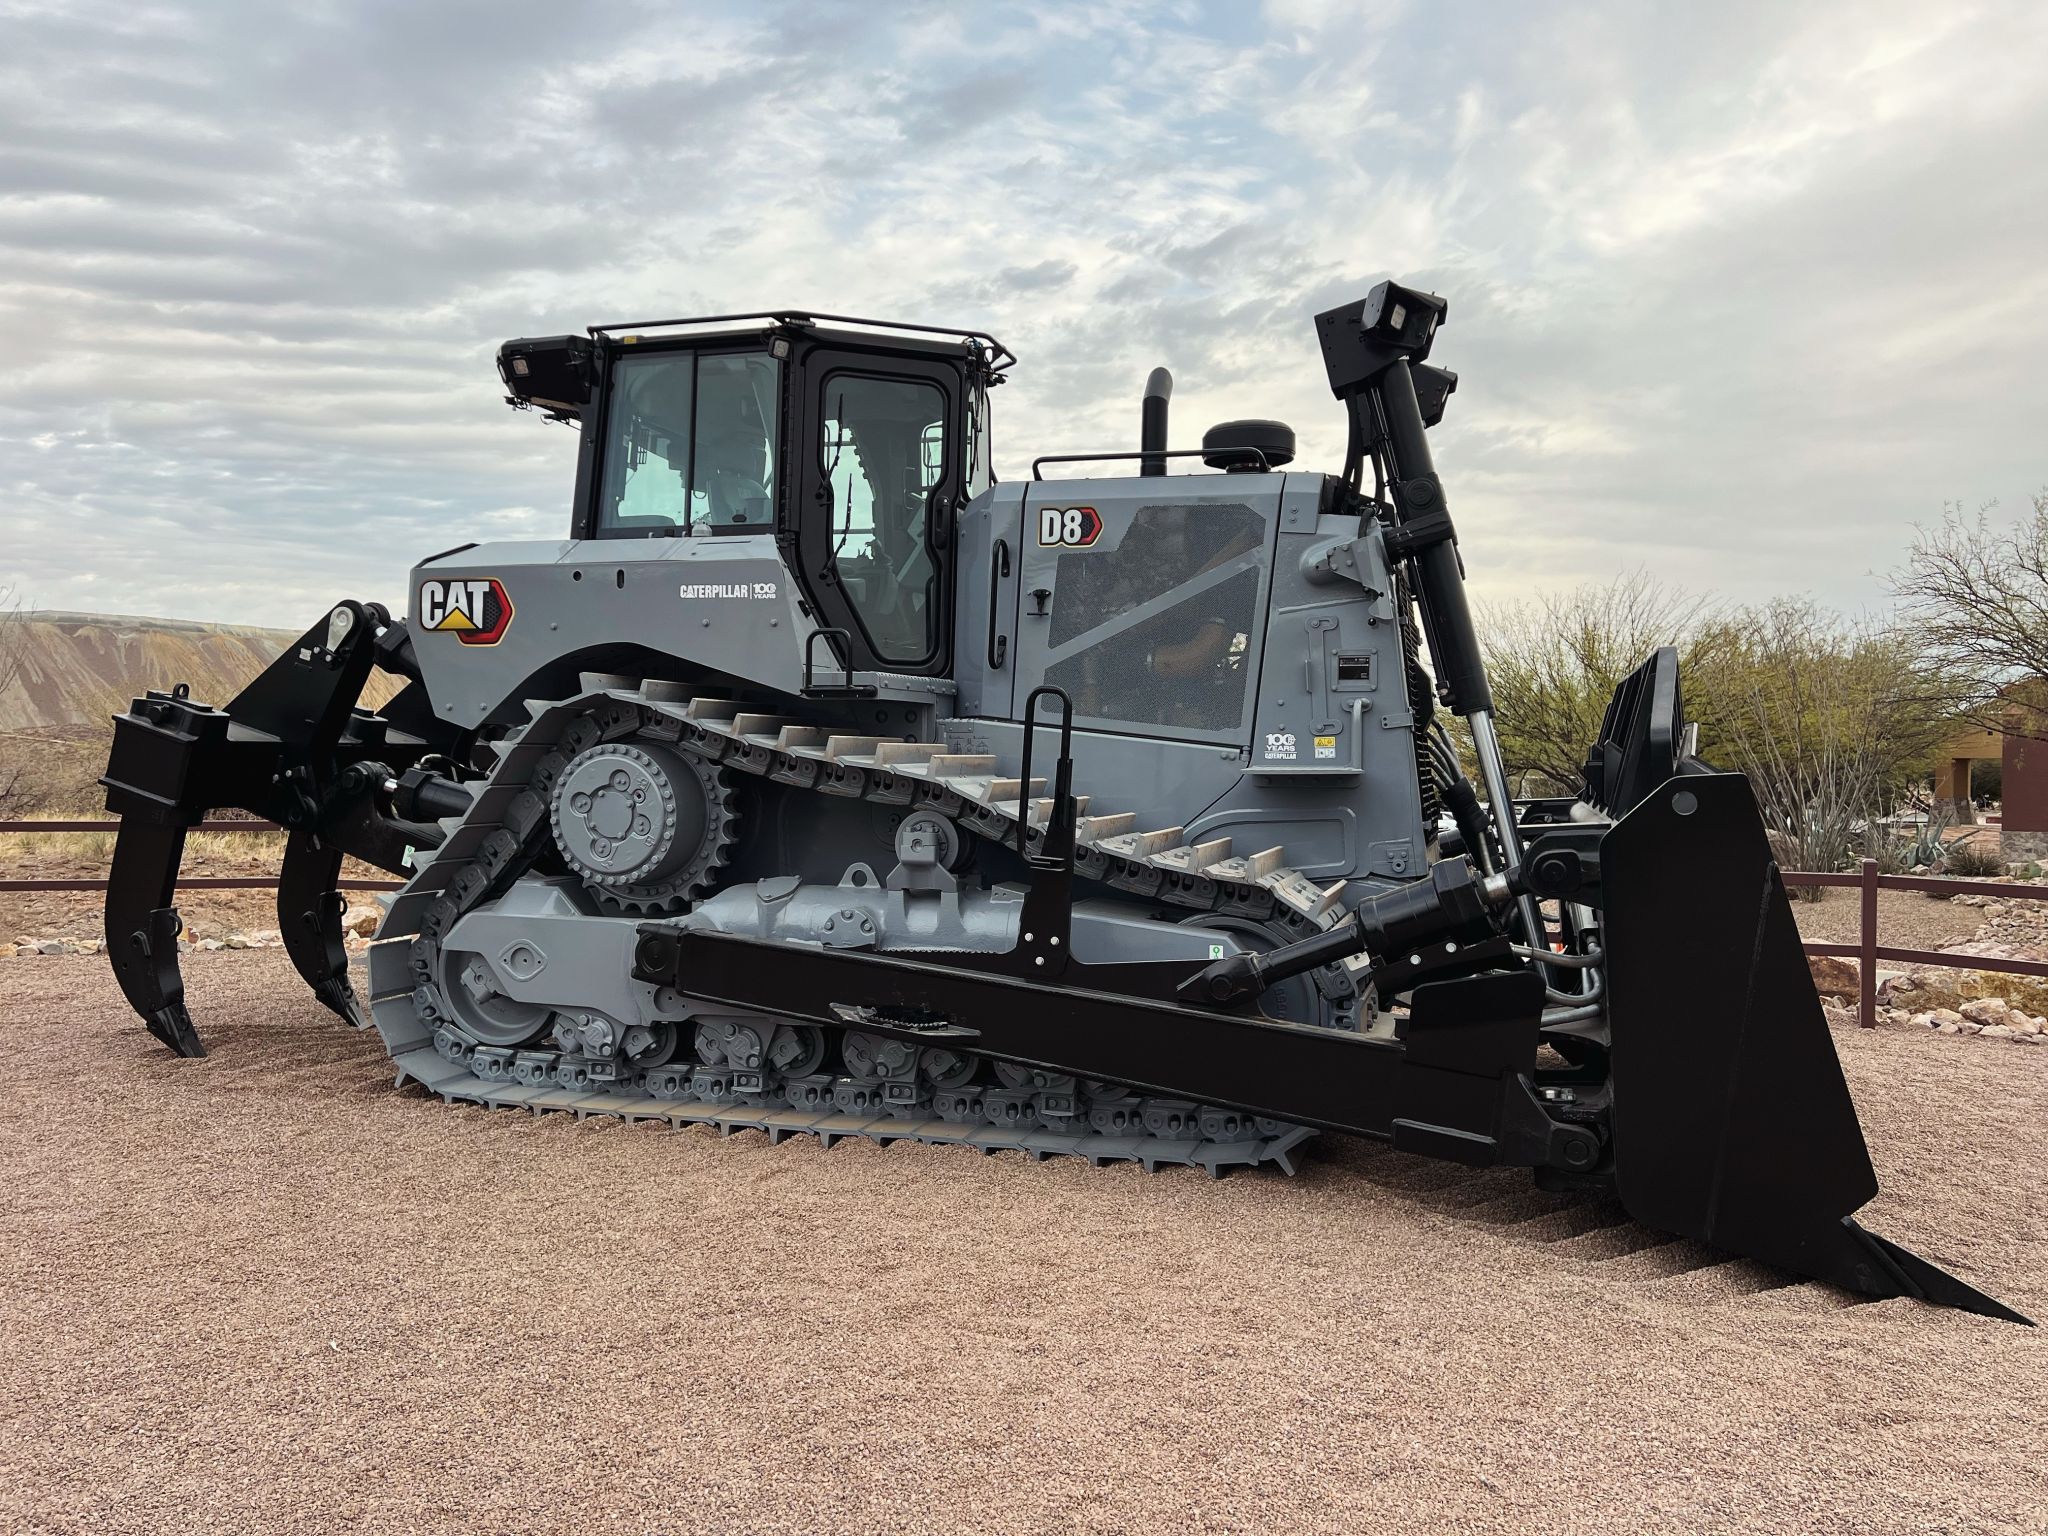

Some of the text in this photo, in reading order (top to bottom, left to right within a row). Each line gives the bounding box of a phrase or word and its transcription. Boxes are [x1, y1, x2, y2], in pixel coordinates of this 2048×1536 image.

[1041, 509, 1082, 544] D8
[680, 582, 777, 599] CATERPILLAR 100
[421, 581, 489, 630] CAT
[1265, 733, 1296, 746] 100
[1264, 752, 1297, 760] CATERPILLAR
